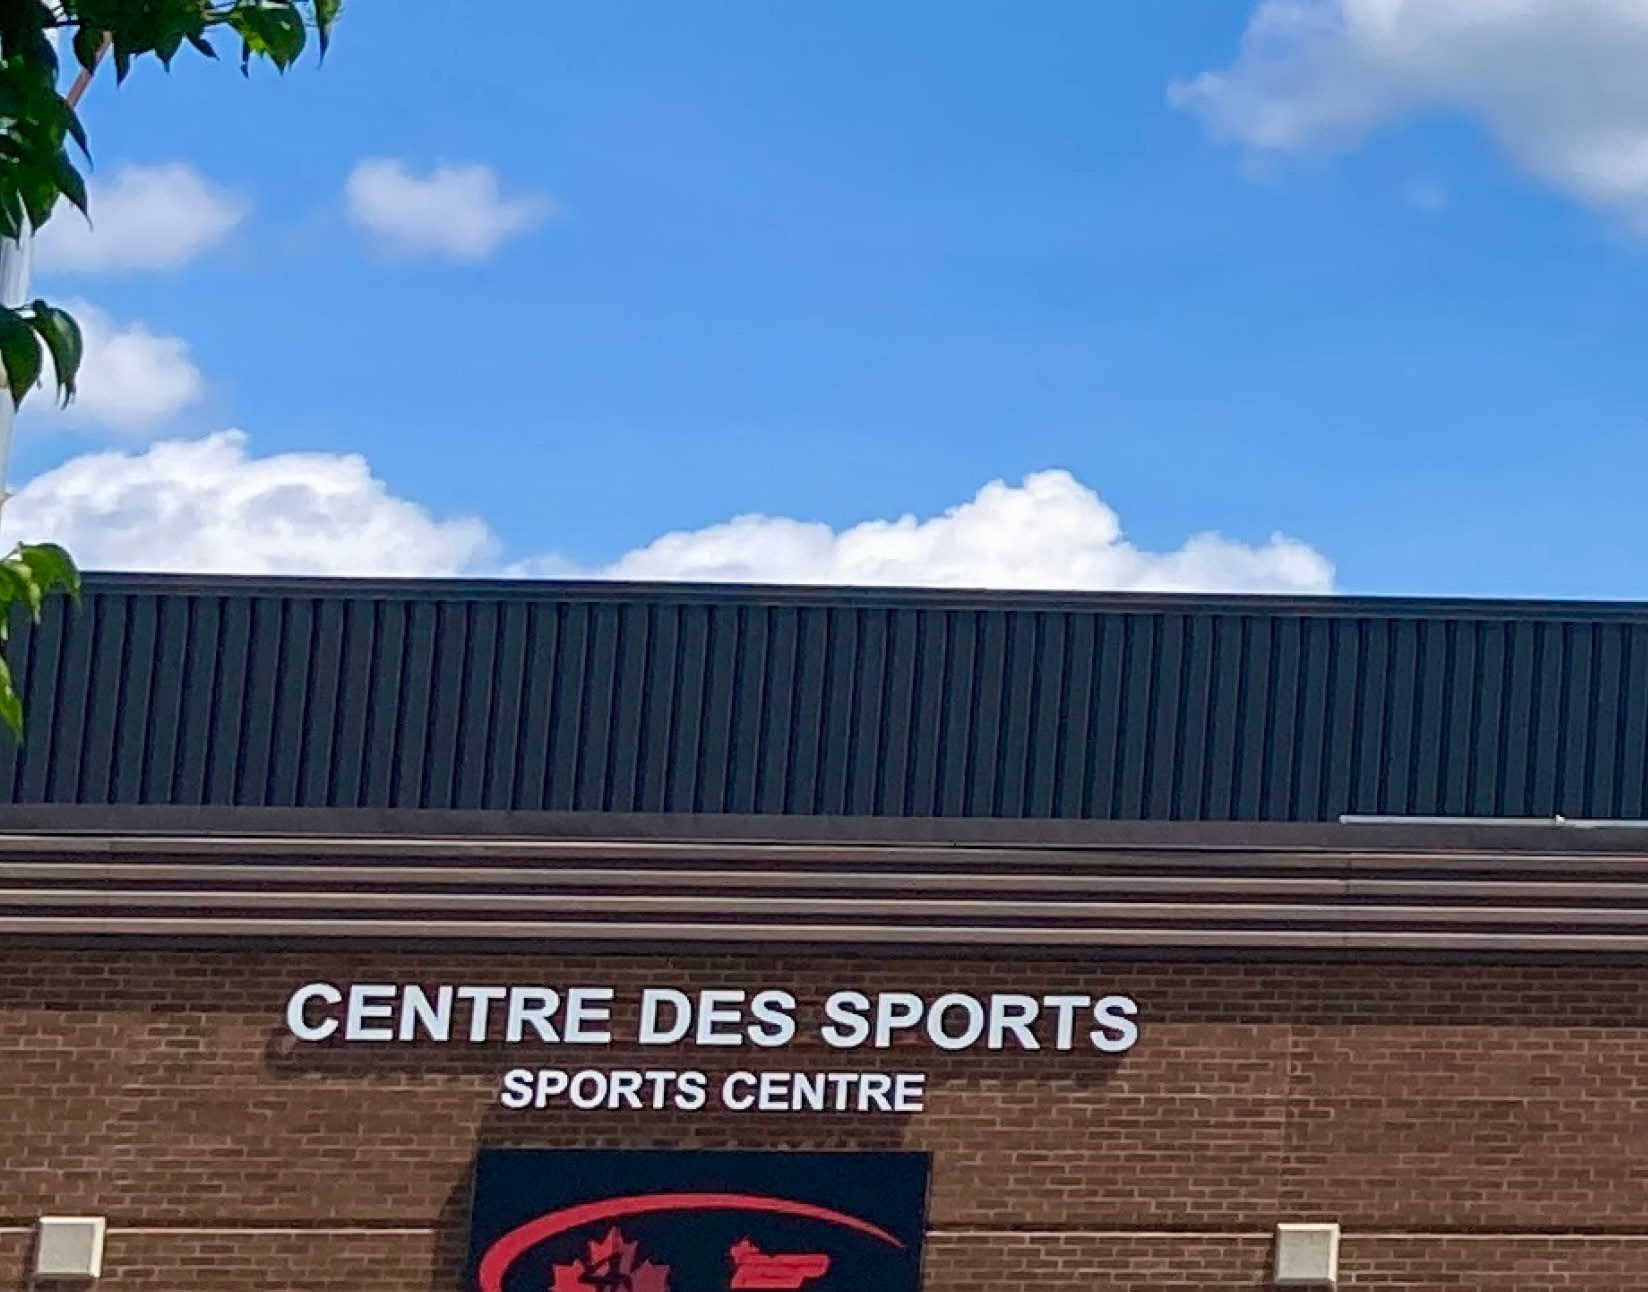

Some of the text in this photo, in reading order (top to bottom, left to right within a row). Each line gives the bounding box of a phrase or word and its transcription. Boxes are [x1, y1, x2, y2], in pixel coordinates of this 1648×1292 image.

[287, 982, 1139, 1052] CENTRE DES SPORTS
[500, 1069, 926, 1112] SPORTS CENTRE
